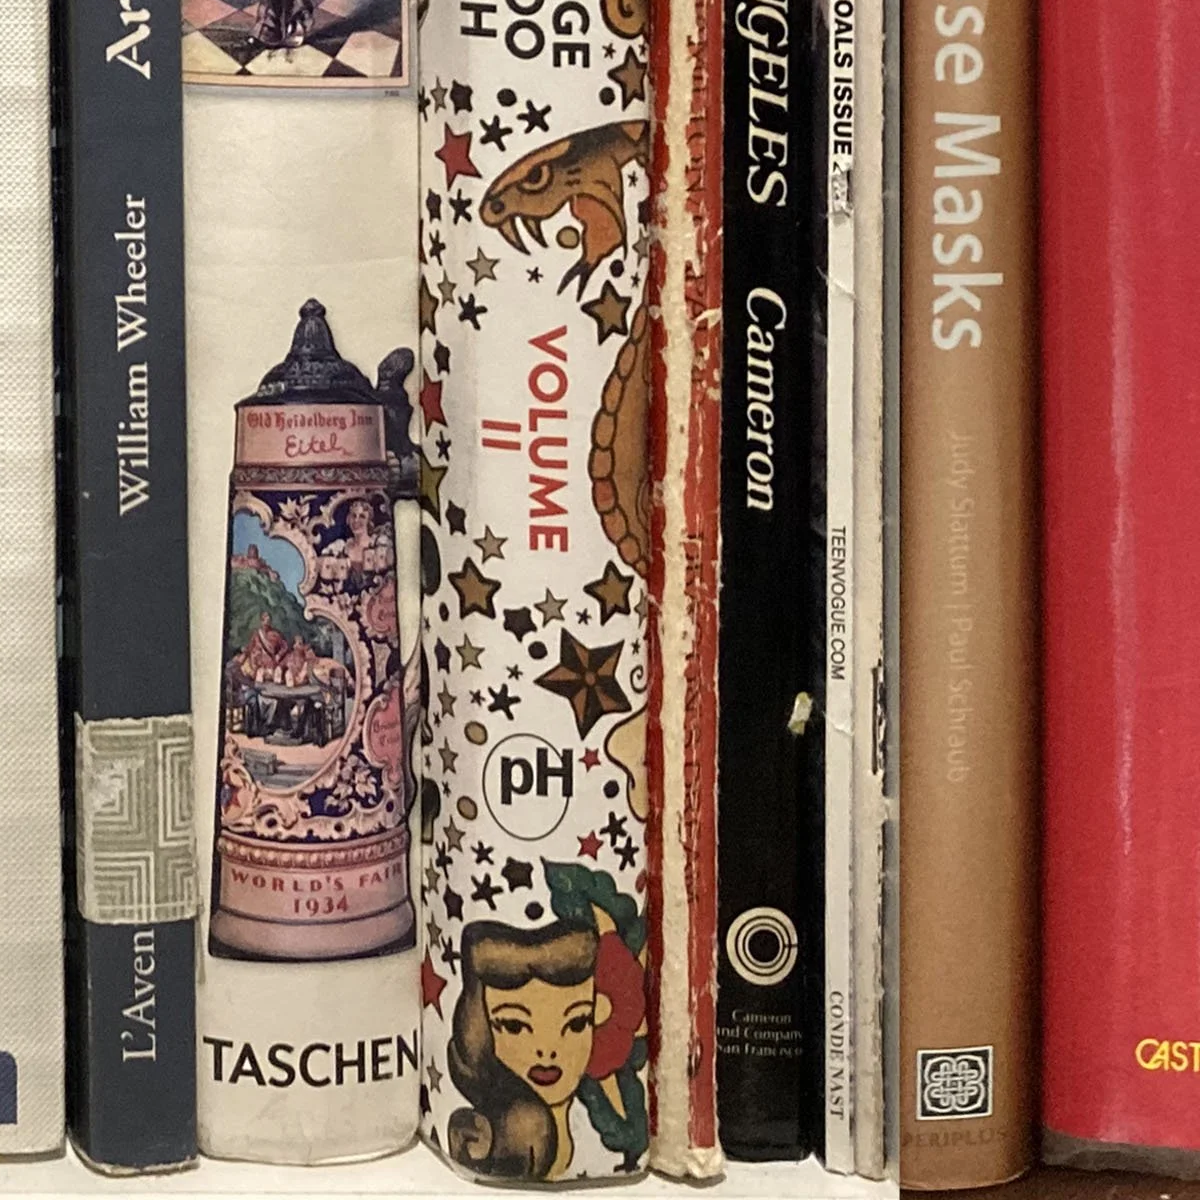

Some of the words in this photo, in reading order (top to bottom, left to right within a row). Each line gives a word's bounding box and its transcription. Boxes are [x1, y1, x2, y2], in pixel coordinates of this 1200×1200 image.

[832, 74, 854, 156] ISSUE
[931, 110, 1004, 351] Masks
[113, 193, 148, 353] Wheeler
[246, 411, 272, 429] Old
[274, 410, 347, 431] Heidelberg
[350, 410, 374, 429] Inn
[745, 286, 788, 512] Cameron
[116, 361, 151, 517] William
[480, 418, 522, 452] II
[527, 323, 569, 554] VOLUME
[946, 430, 976, 490] Judy
[830, 525, 847, 681] TEENVOGUE.COM
[947, 616, 975, 671] Paul
[945, 678, 974, 784] Schraub
[499, 746, 575, 806] pH
[230, 867, 345, 893] WORLD'S
[292, 895, 350, 917] 1934
[120, 927, 158, 1064] L'Aven
[731, 1008, 793, 1025] Cameron
[202, 1028, 419, 1089] TASCHEN
[829, 1065, 845, 1121] NAST
